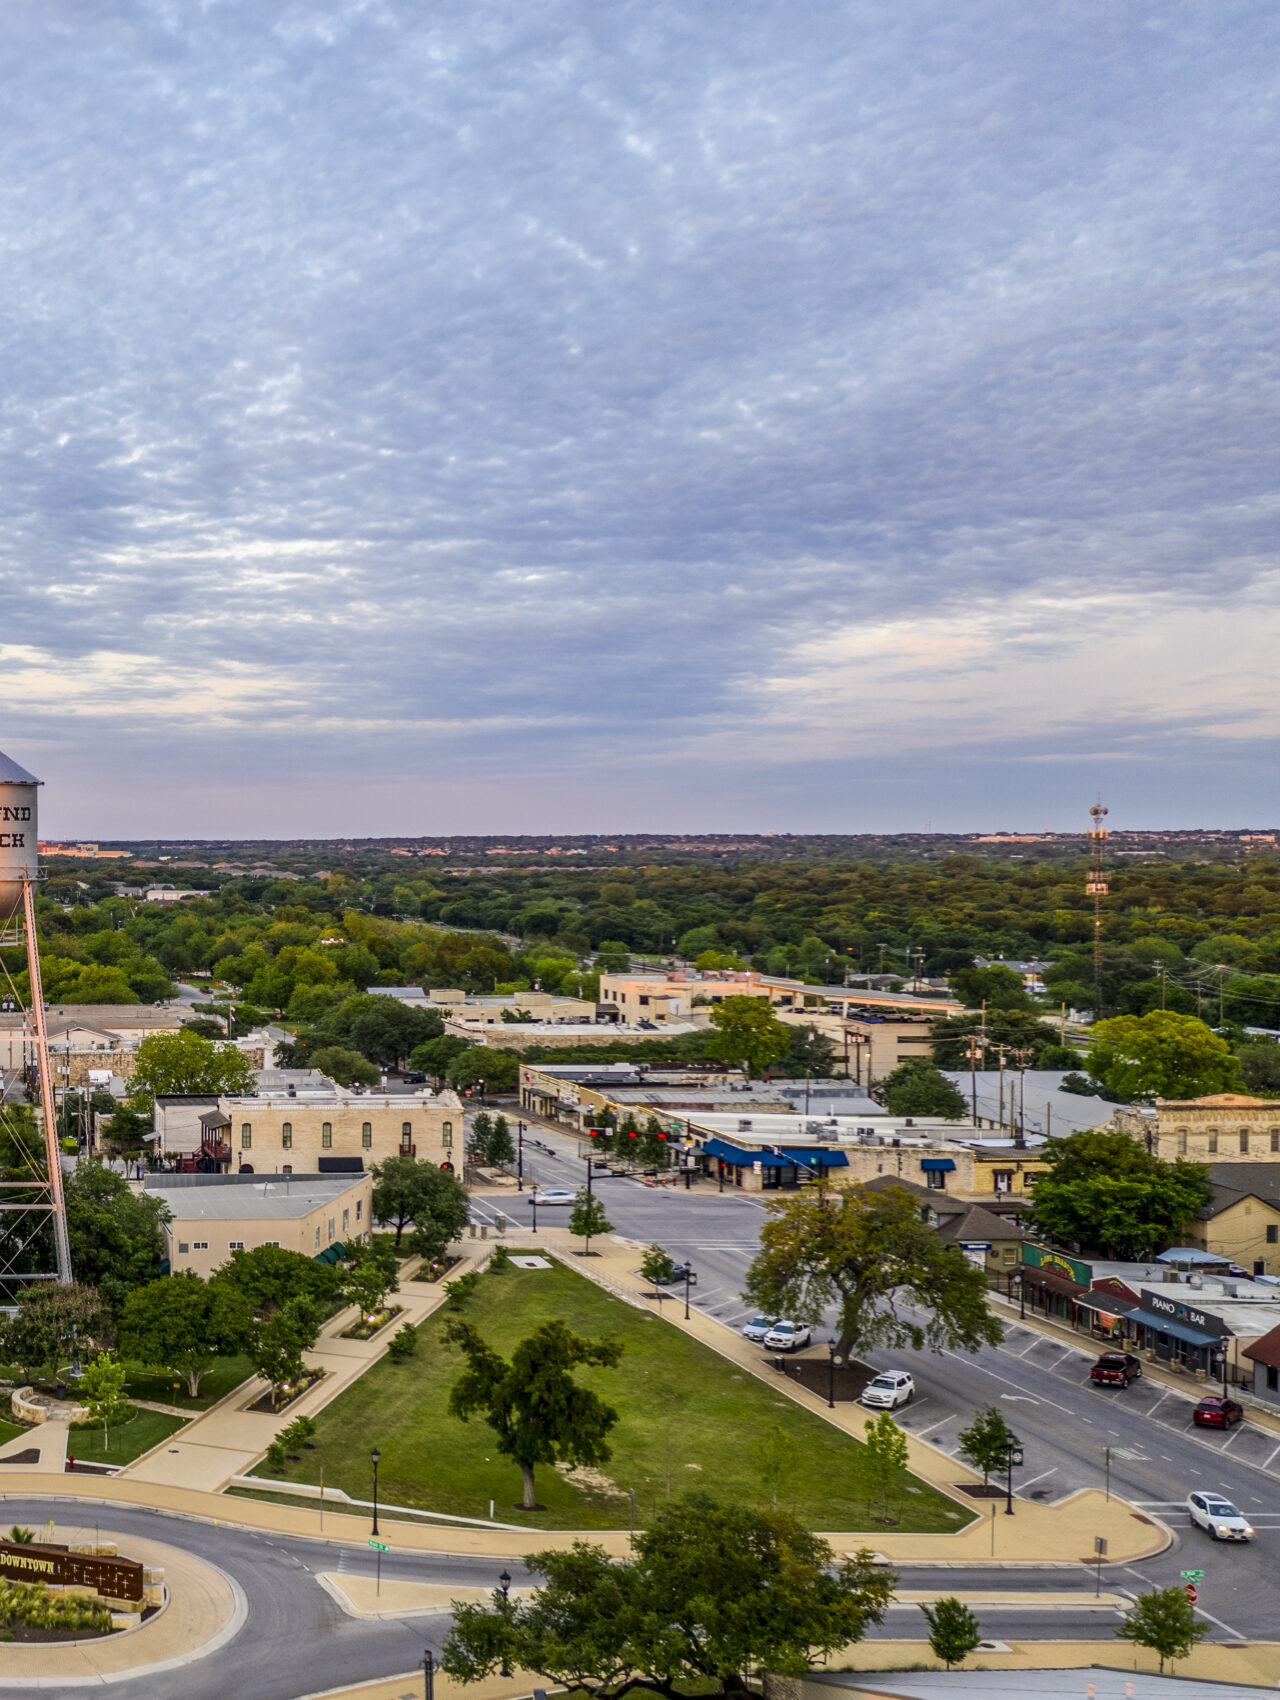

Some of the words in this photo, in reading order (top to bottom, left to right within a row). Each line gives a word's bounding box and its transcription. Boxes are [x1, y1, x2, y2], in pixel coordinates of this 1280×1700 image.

[1152, 1297, 1175, 1314] PIANO
[1190, 1312, 1206, 1326] BAR
[0, 1553, 55, 1574] DOWNTOWN
